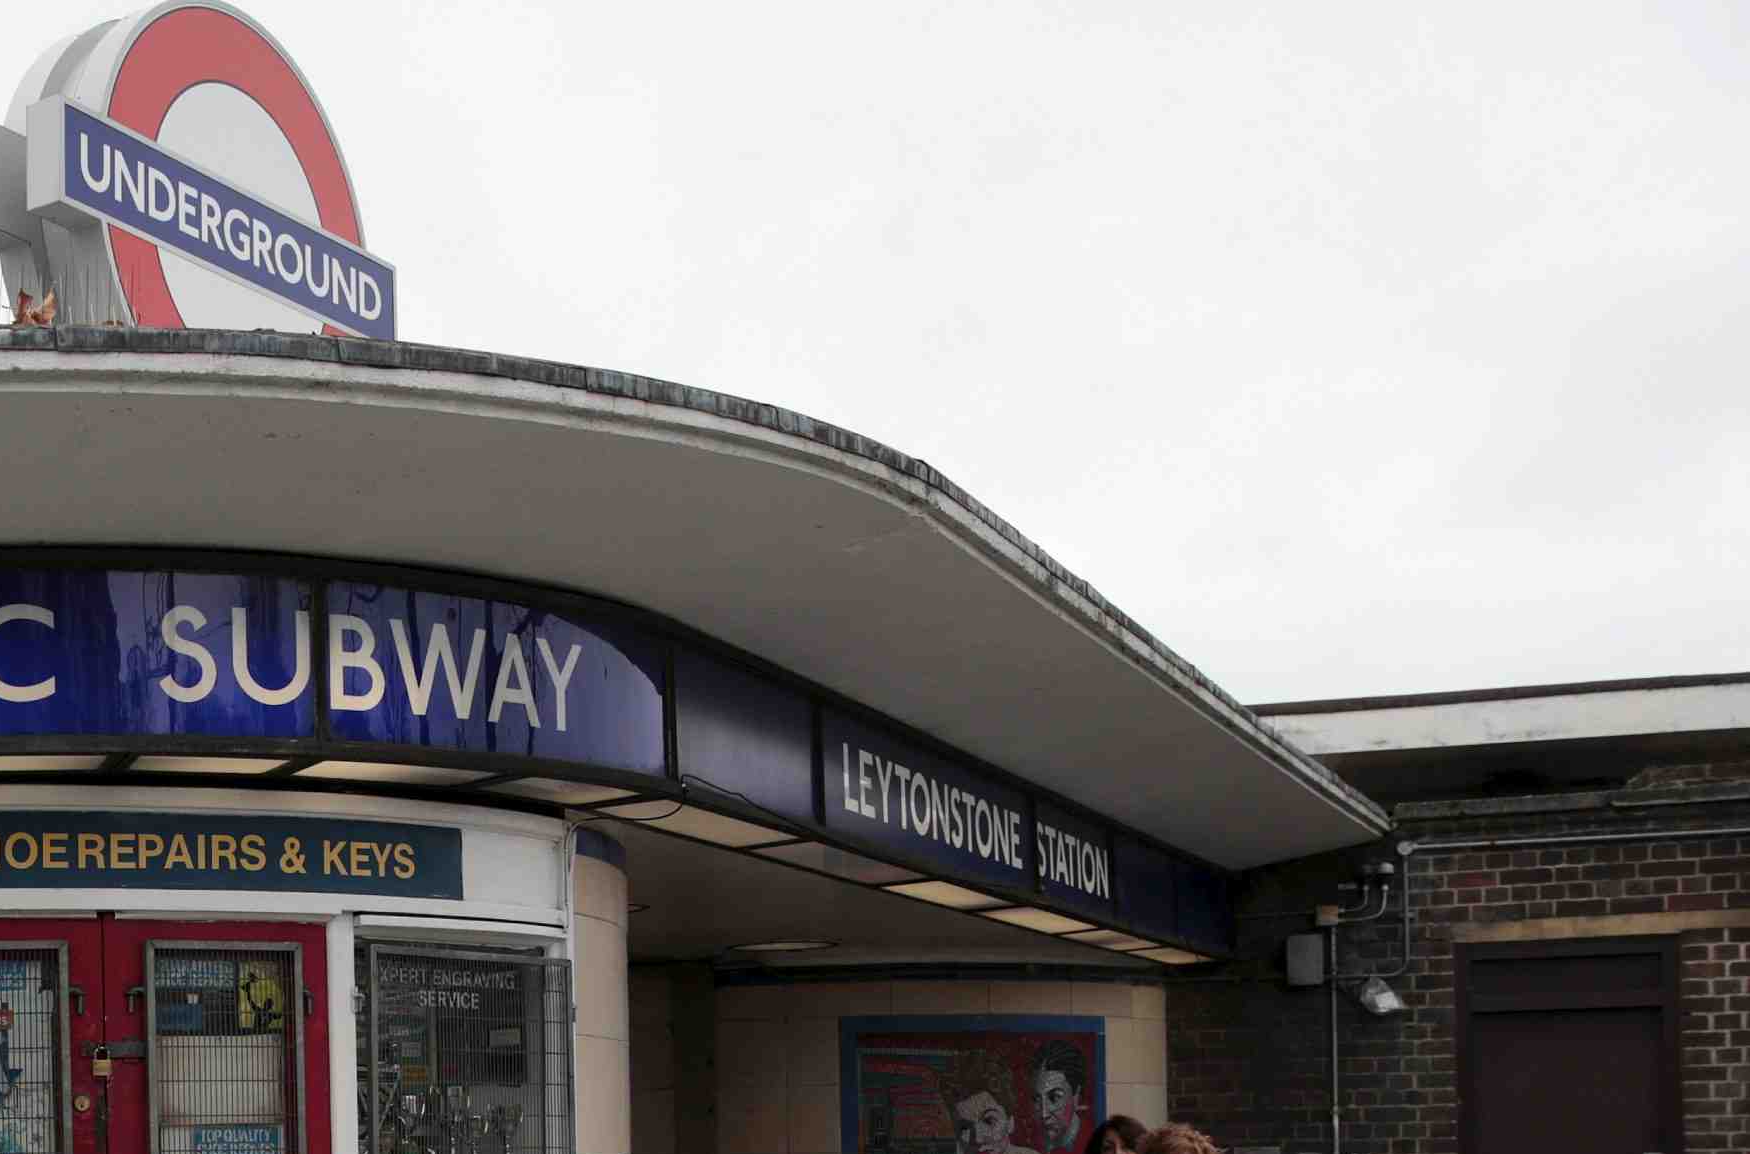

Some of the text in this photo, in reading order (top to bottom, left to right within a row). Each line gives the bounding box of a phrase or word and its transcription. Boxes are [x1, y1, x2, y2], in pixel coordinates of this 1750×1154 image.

[79, 132, 382, 321] UNDERGROUND
[160, 605, 582, 731] SUBWAY
[78, 833, 267, 872] REPAIRS
[279, 836, 307, 875] &
[322, 840, 415, 878] KEYS
[842, 742, 1110, 899] LEYTONSTONE STATION
[379, 967, 515, 992] XPERT ENGRAVING
[418, 990, 481, 1010] SERVICE
